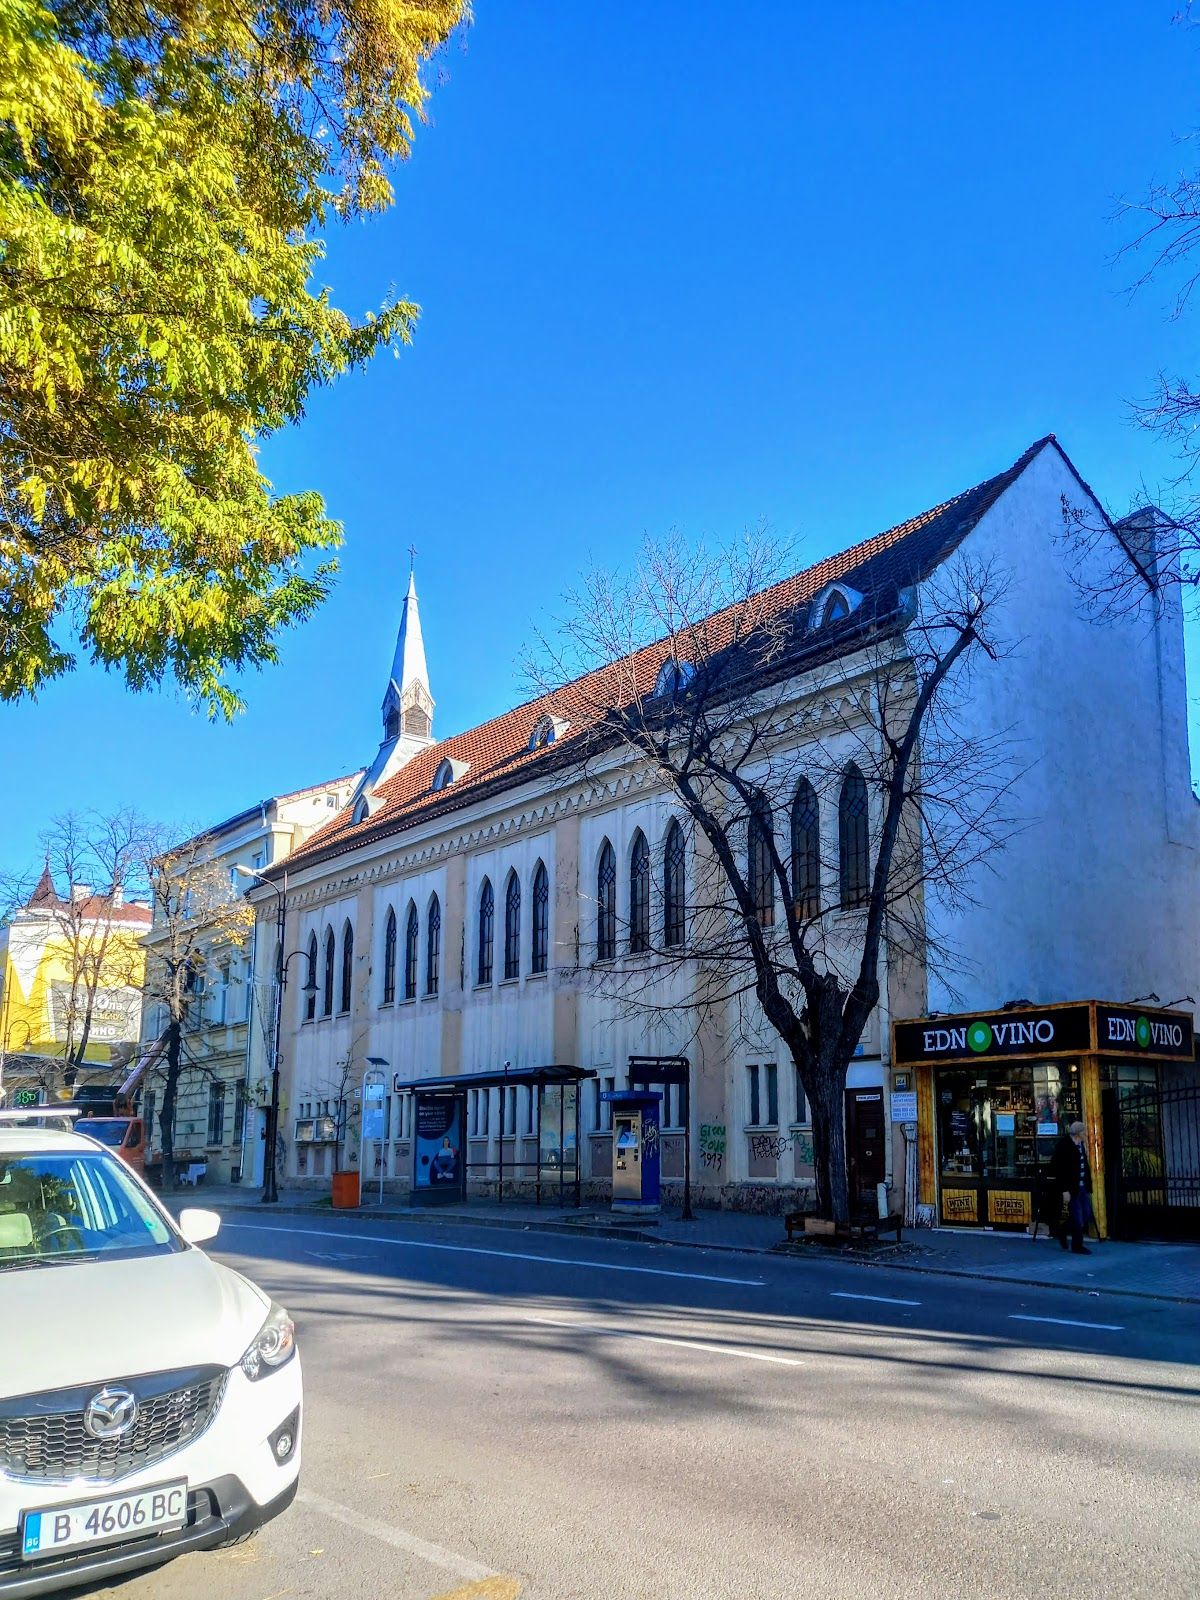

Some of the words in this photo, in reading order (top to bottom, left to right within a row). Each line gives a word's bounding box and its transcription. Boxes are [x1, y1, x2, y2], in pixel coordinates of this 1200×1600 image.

[949, 1198, 970, 1207] WINE
[995, 1200, 1024, 1208] SPIRITS
[53, 1514, 71, 1543] B
[84, 1498, 146, 1536] 4606
[152, 1489, 182, 1520] BC
[26, 1537, 39, 1547] BG
